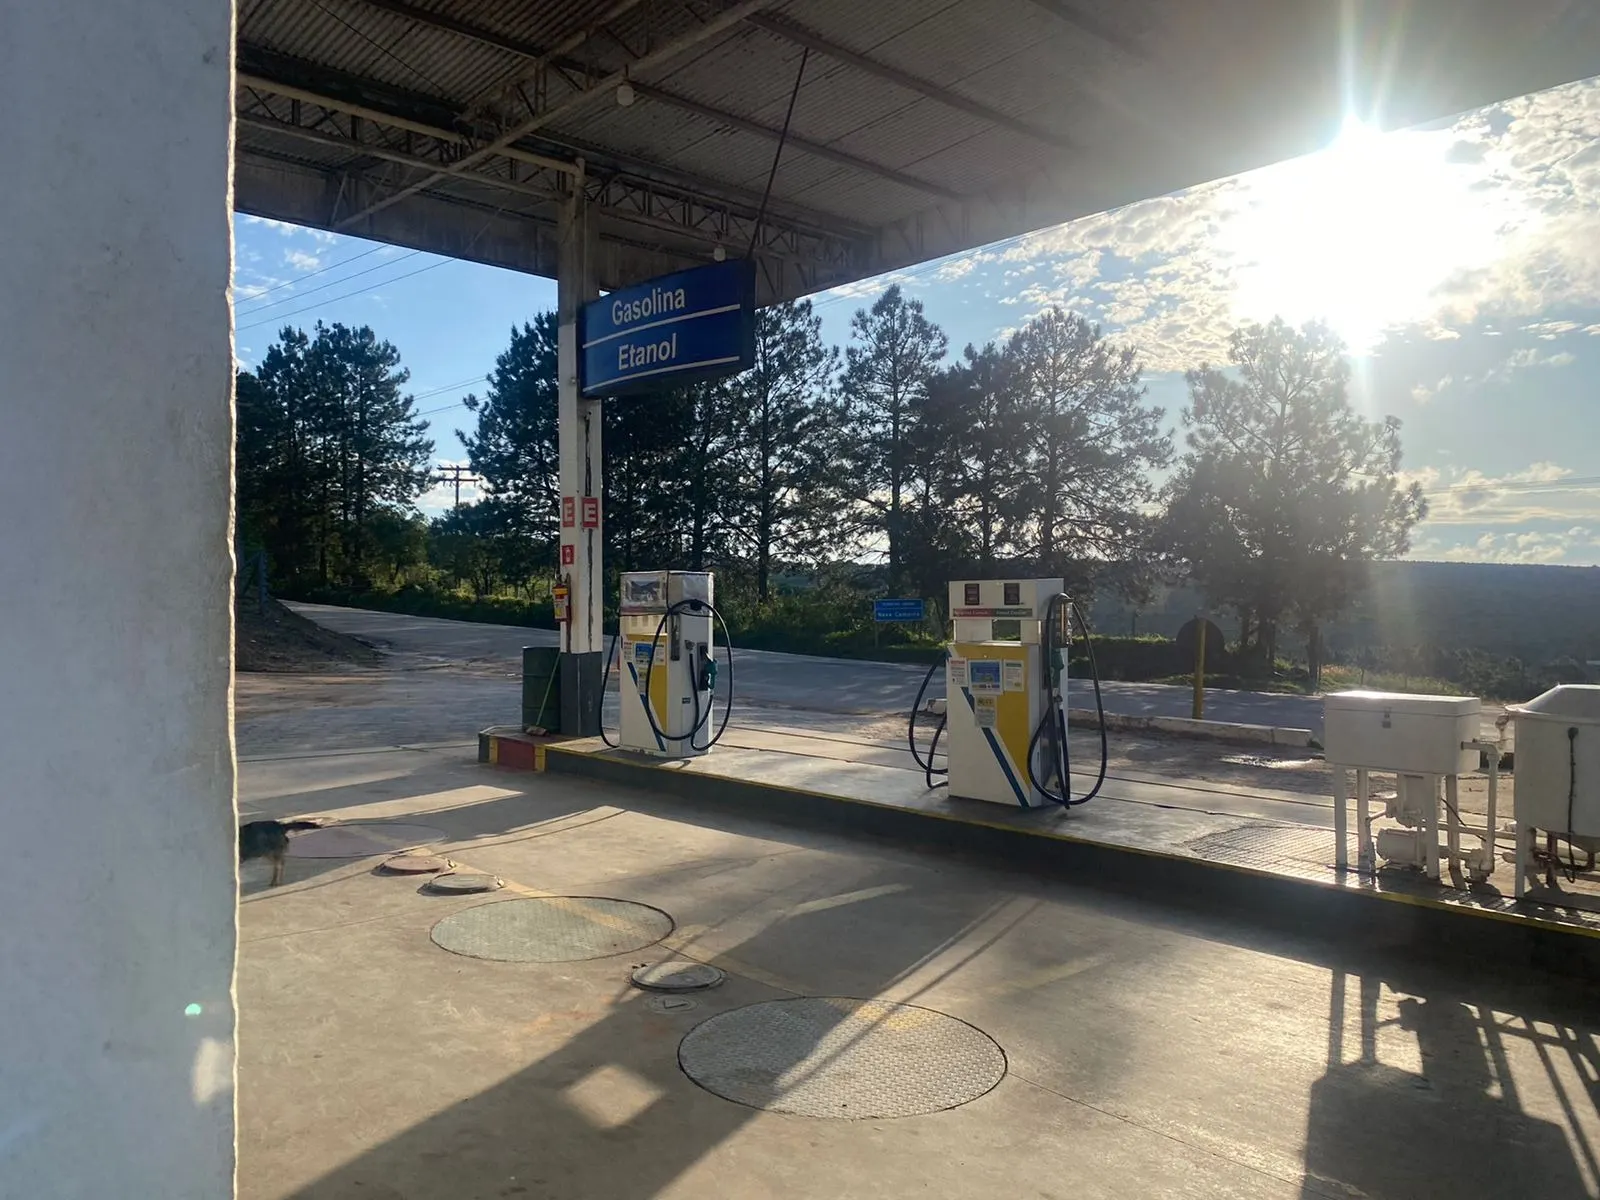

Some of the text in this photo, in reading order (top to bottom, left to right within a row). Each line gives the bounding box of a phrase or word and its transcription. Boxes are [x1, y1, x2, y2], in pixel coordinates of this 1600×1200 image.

[612, 287, 686, 326] Gasolina
[618, 332, 677, 371] Etanol
[584, 503, 596, 522] E
